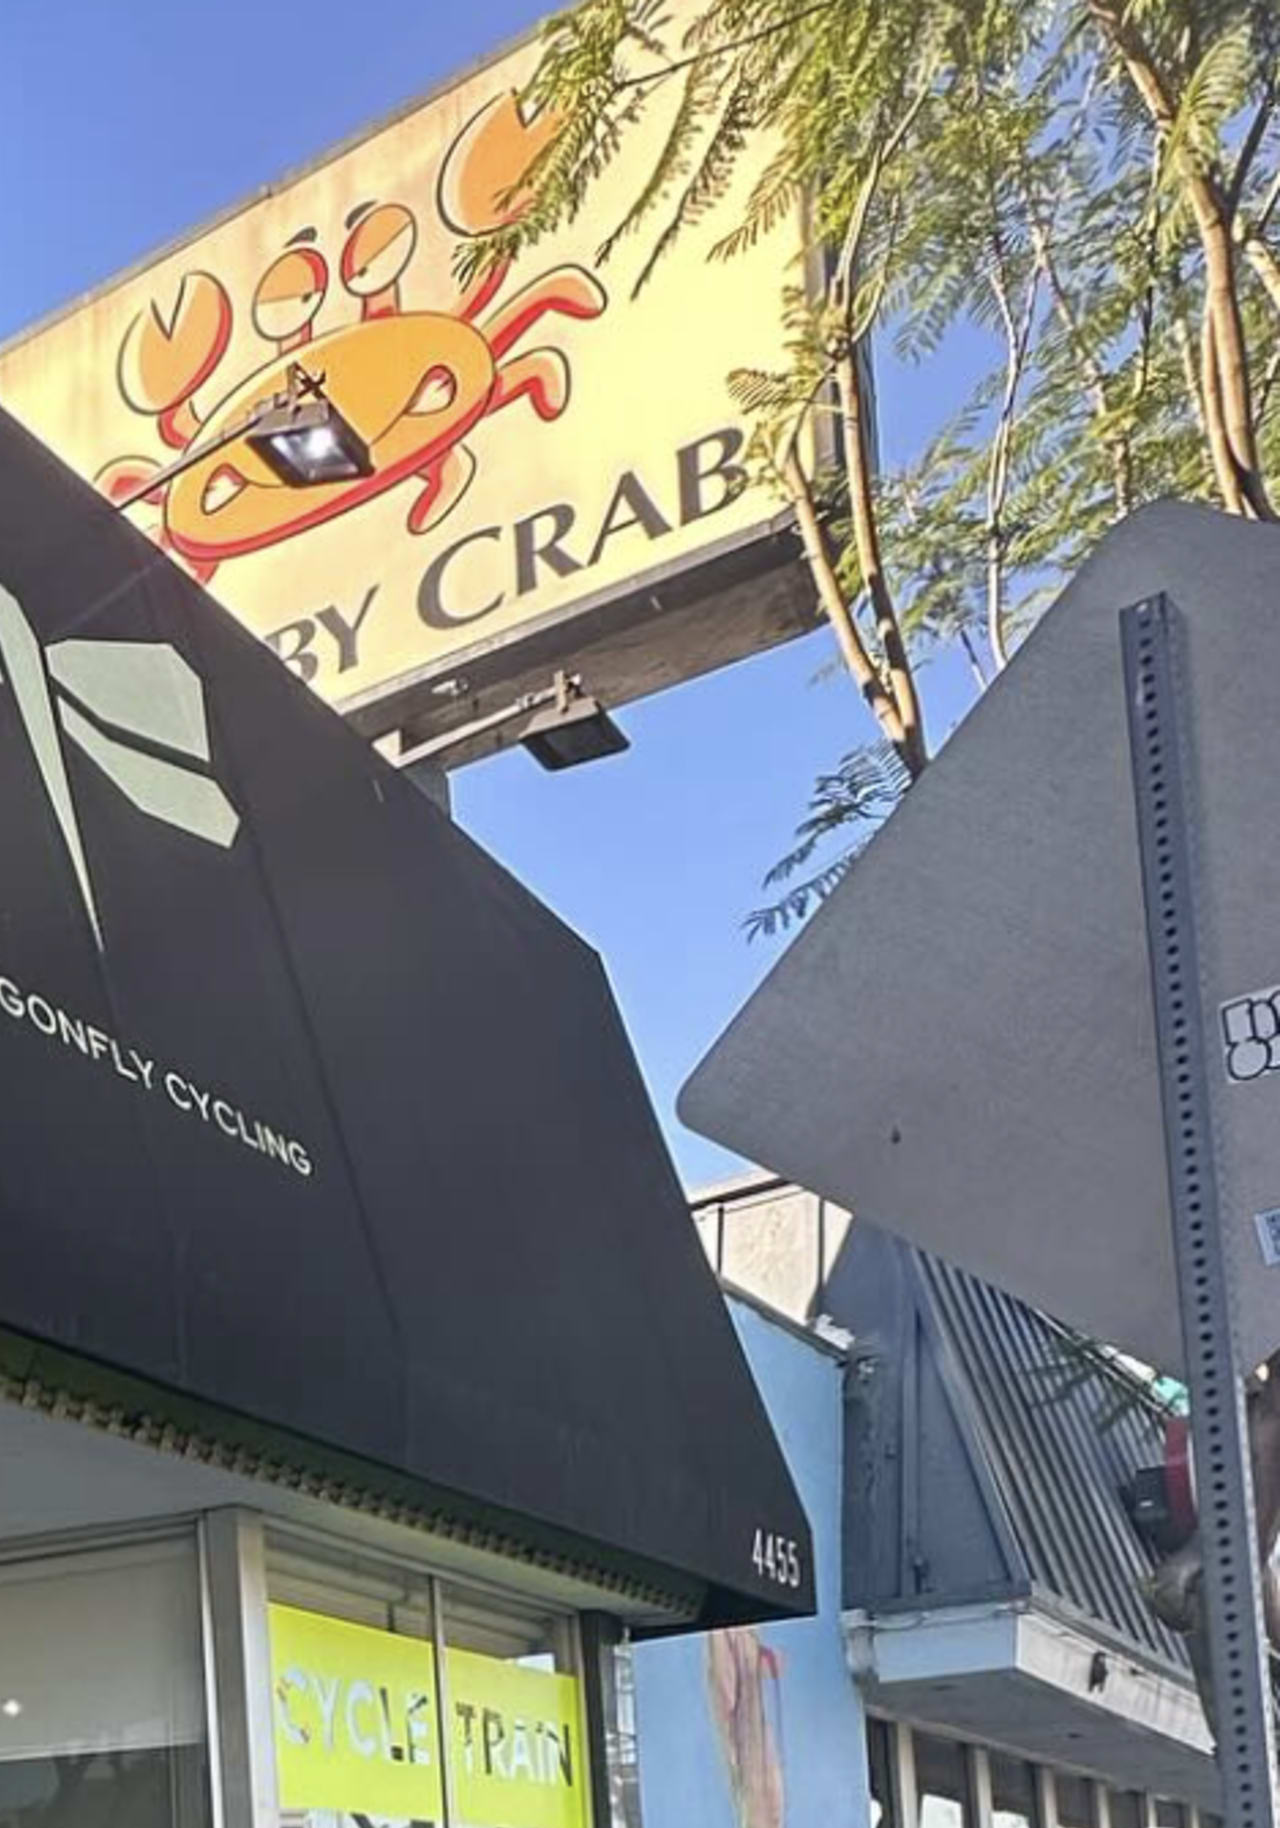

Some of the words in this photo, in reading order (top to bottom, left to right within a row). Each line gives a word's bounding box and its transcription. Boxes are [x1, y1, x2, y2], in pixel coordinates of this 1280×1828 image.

[416, 427, 748, 630] CRAB
[165, 1072, 312, 1175] CYCLING
[752, 1528, 800, 1588] 4455
[276, 1665, 431, 1765] CYCLE
[455, 1701, 573, 1787] TRAIN
